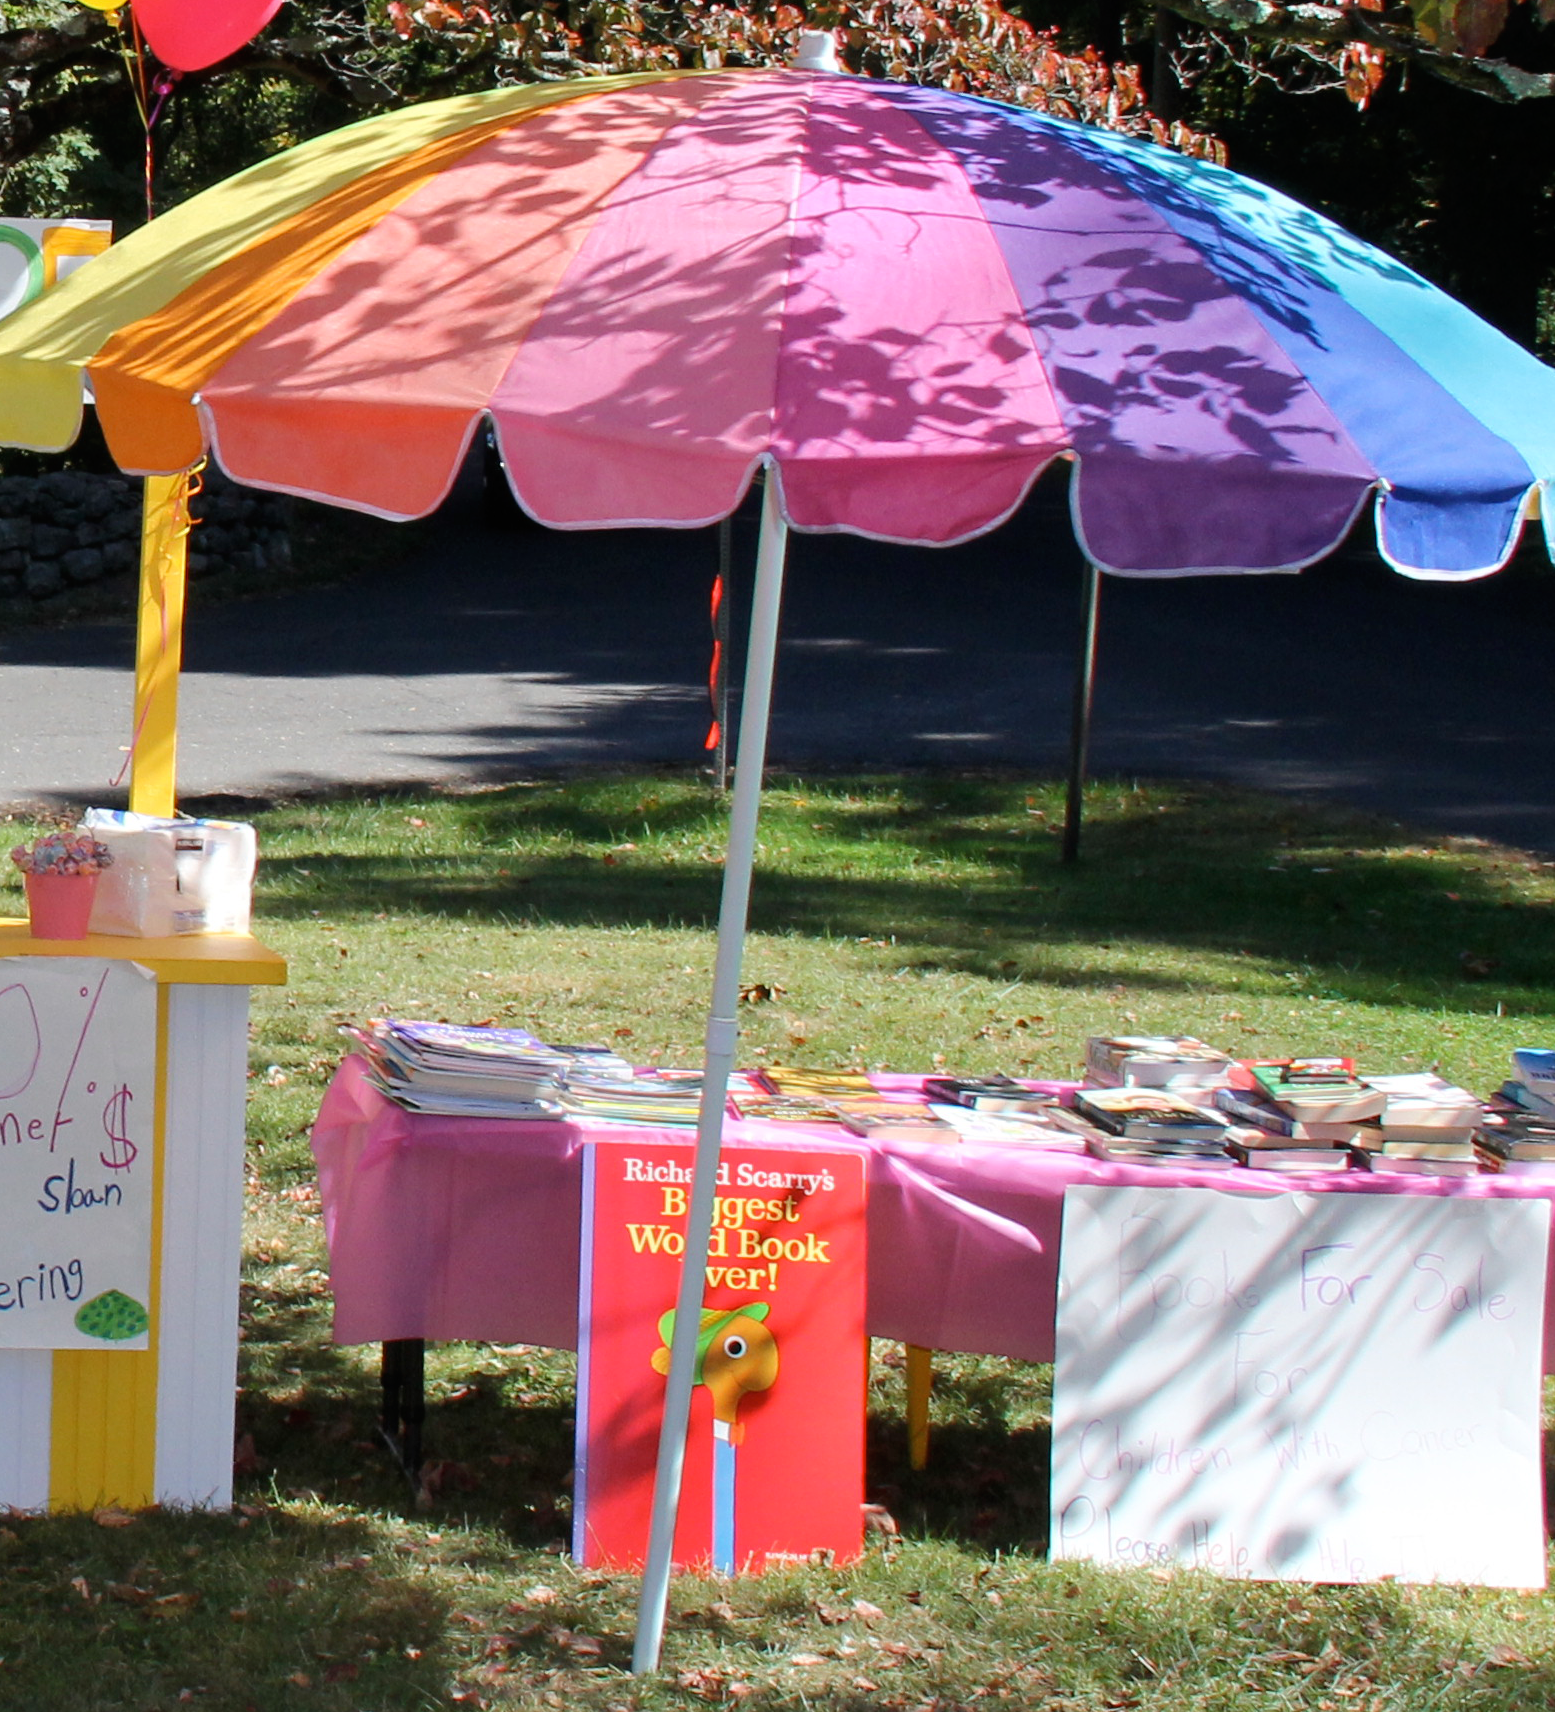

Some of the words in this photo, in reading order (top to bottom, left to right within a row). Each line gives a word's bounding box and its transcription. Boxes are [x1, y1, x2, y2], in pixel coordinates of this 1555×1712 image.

[736, 1162, 836, 1196] Scarry's
[660, 1186, 801, 1230] Bgest
[625, 1223, 730, 1258] Wod
[736, 1228, 831, 1263] Book
[678, 1257, 779, 1292] ver!
[1300, 1242, 1373, 1312] For
[1412, 1252, 1517, 1322] Sale
[1232, 1328, 1308, 1406] For
[1078, 1418, 1232, 1482] Children
[1265, 1420, 1341, 1470] With
[1360, 1410, 1483, 1462] Cancer
[1191, 1519, 1249, 1580] Help
